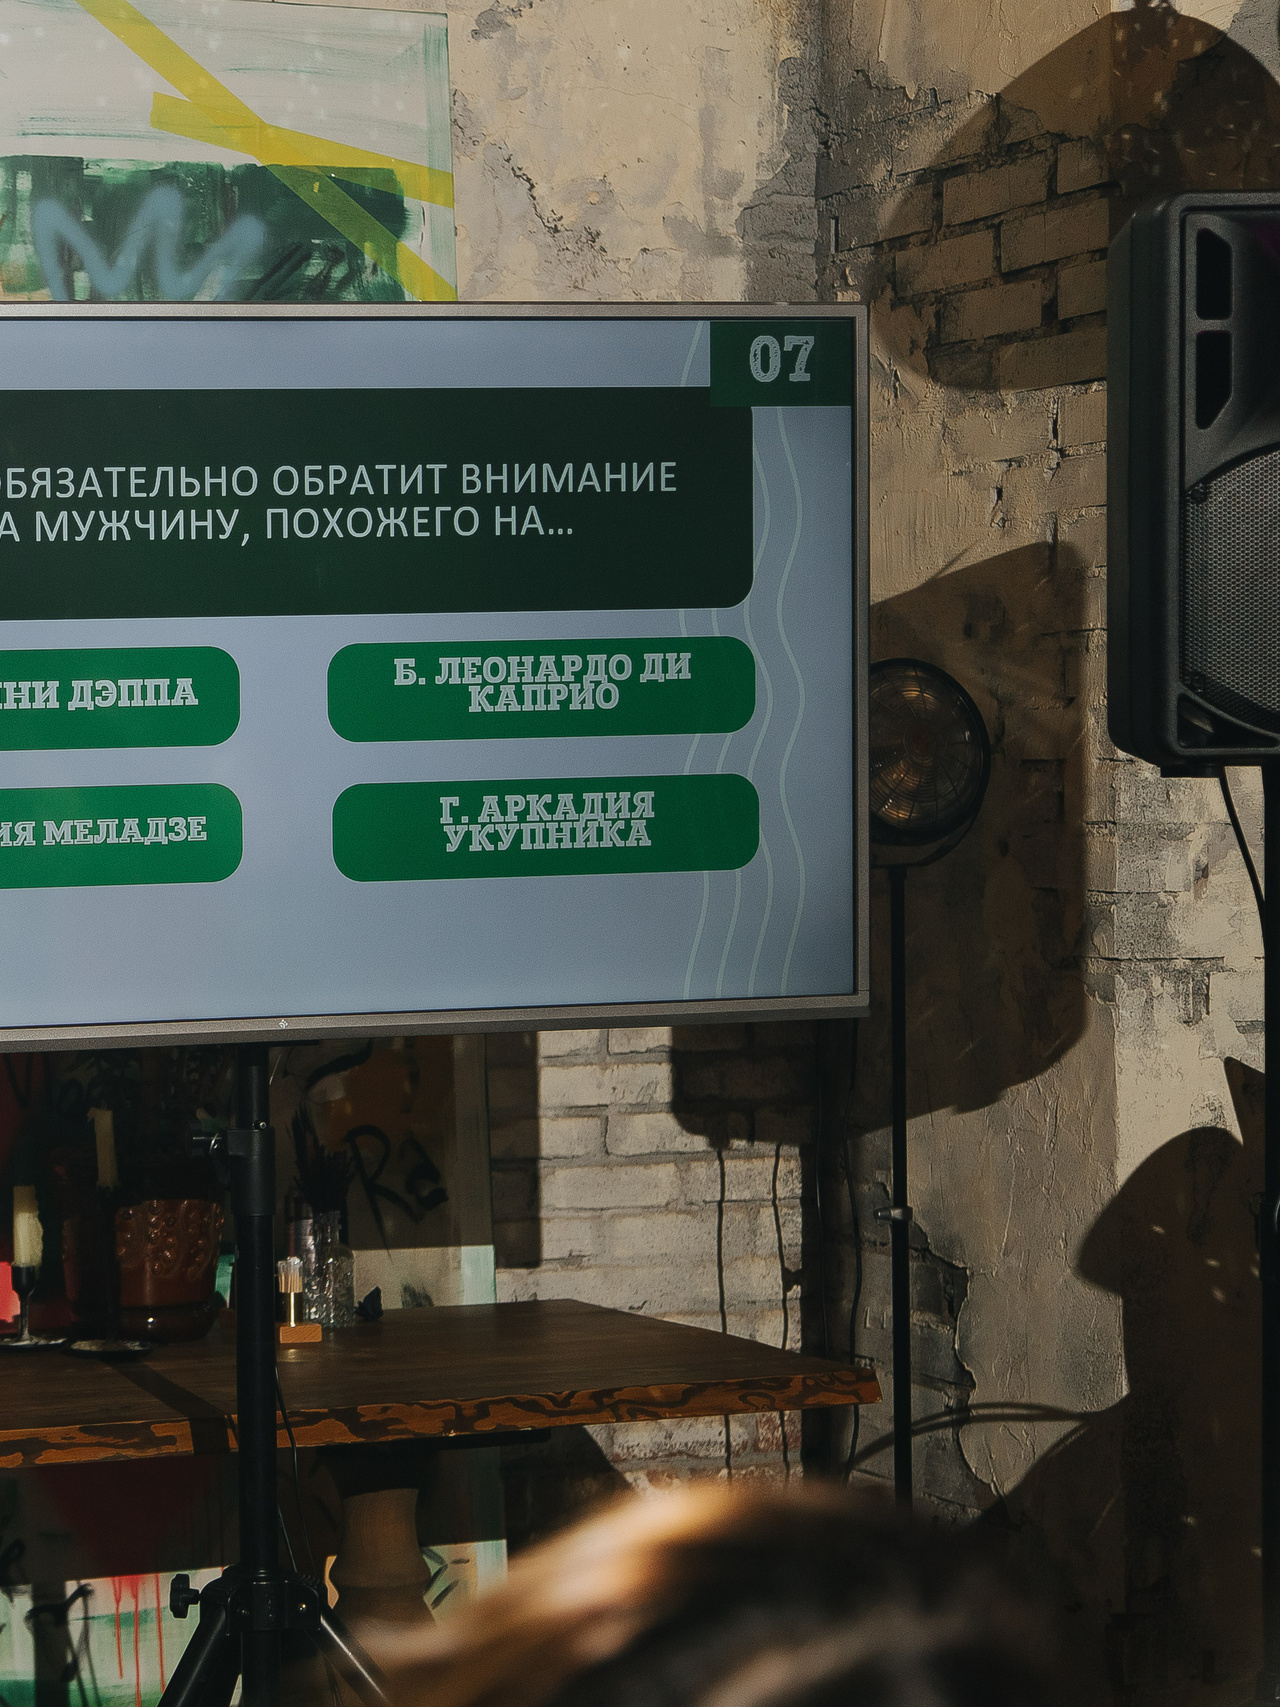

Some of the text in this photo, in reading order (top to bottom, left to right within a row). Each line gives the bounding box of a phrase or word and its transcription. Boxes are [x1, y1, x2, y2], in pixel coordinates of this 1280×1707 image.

[749, 335, 815, 382] 07
[272, 464, 448, 496] ОБРАТИТ
[462, 461, 677, 494] ВНИМАНИЕ
[35, 508, 250, 547] МУЖЧИНУ,
[266, 506, 479, 539] ПОХОЖЕГО
[495, 505, 573, 536] НА...
[393, 652, 692, 687] Б. ЛЕОНАРДО ДИ
[67, 677, 199, 711] ДЭППА
[468, 682, 620, 713] КАПРИО
[439, 791, 655, 824] Г. АРКАДИЯ
[42, 816, 208, 846] МЕЛАДЗЕ
[443, 819, 652, 853] УКУПНИКА
